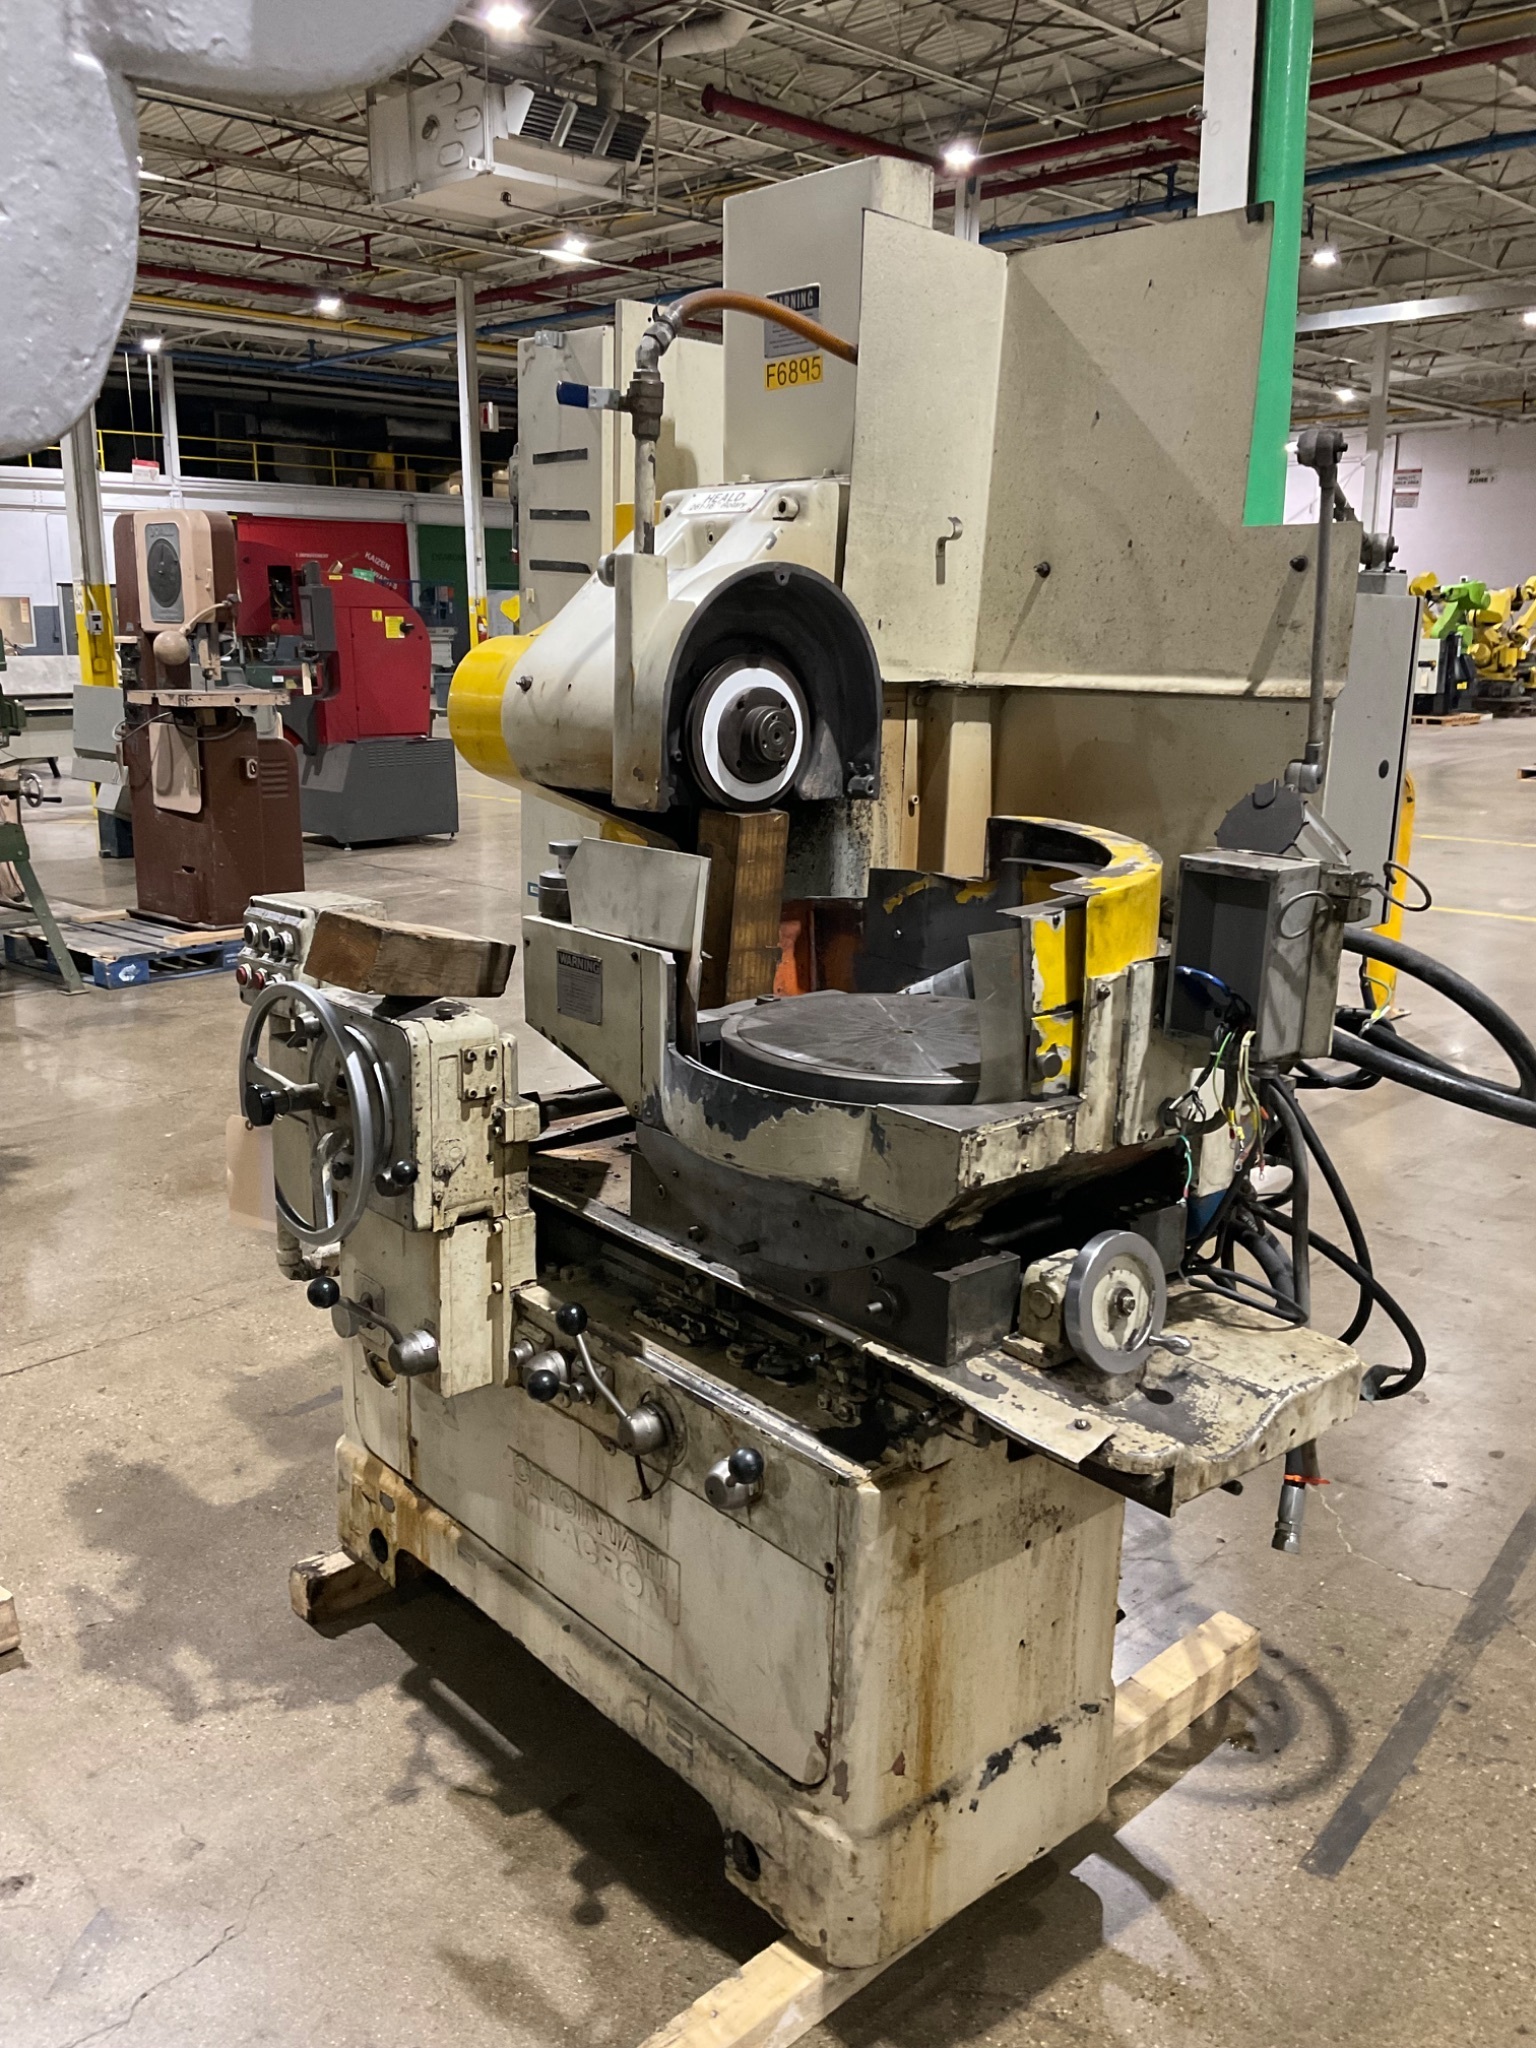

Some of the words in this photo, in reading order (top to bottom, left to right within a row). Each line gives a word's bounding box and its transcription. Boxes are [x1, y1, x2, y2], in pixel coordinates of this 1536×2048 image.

[766, 356, 821, 388] F6895
[365, 551, 391, 571] KAIZEN
[560, 953, 600, 974] WARNING
[513, 1456, 664, 1580] CINCINNATI
[513, 1480, 670, 1618] MILACRON
